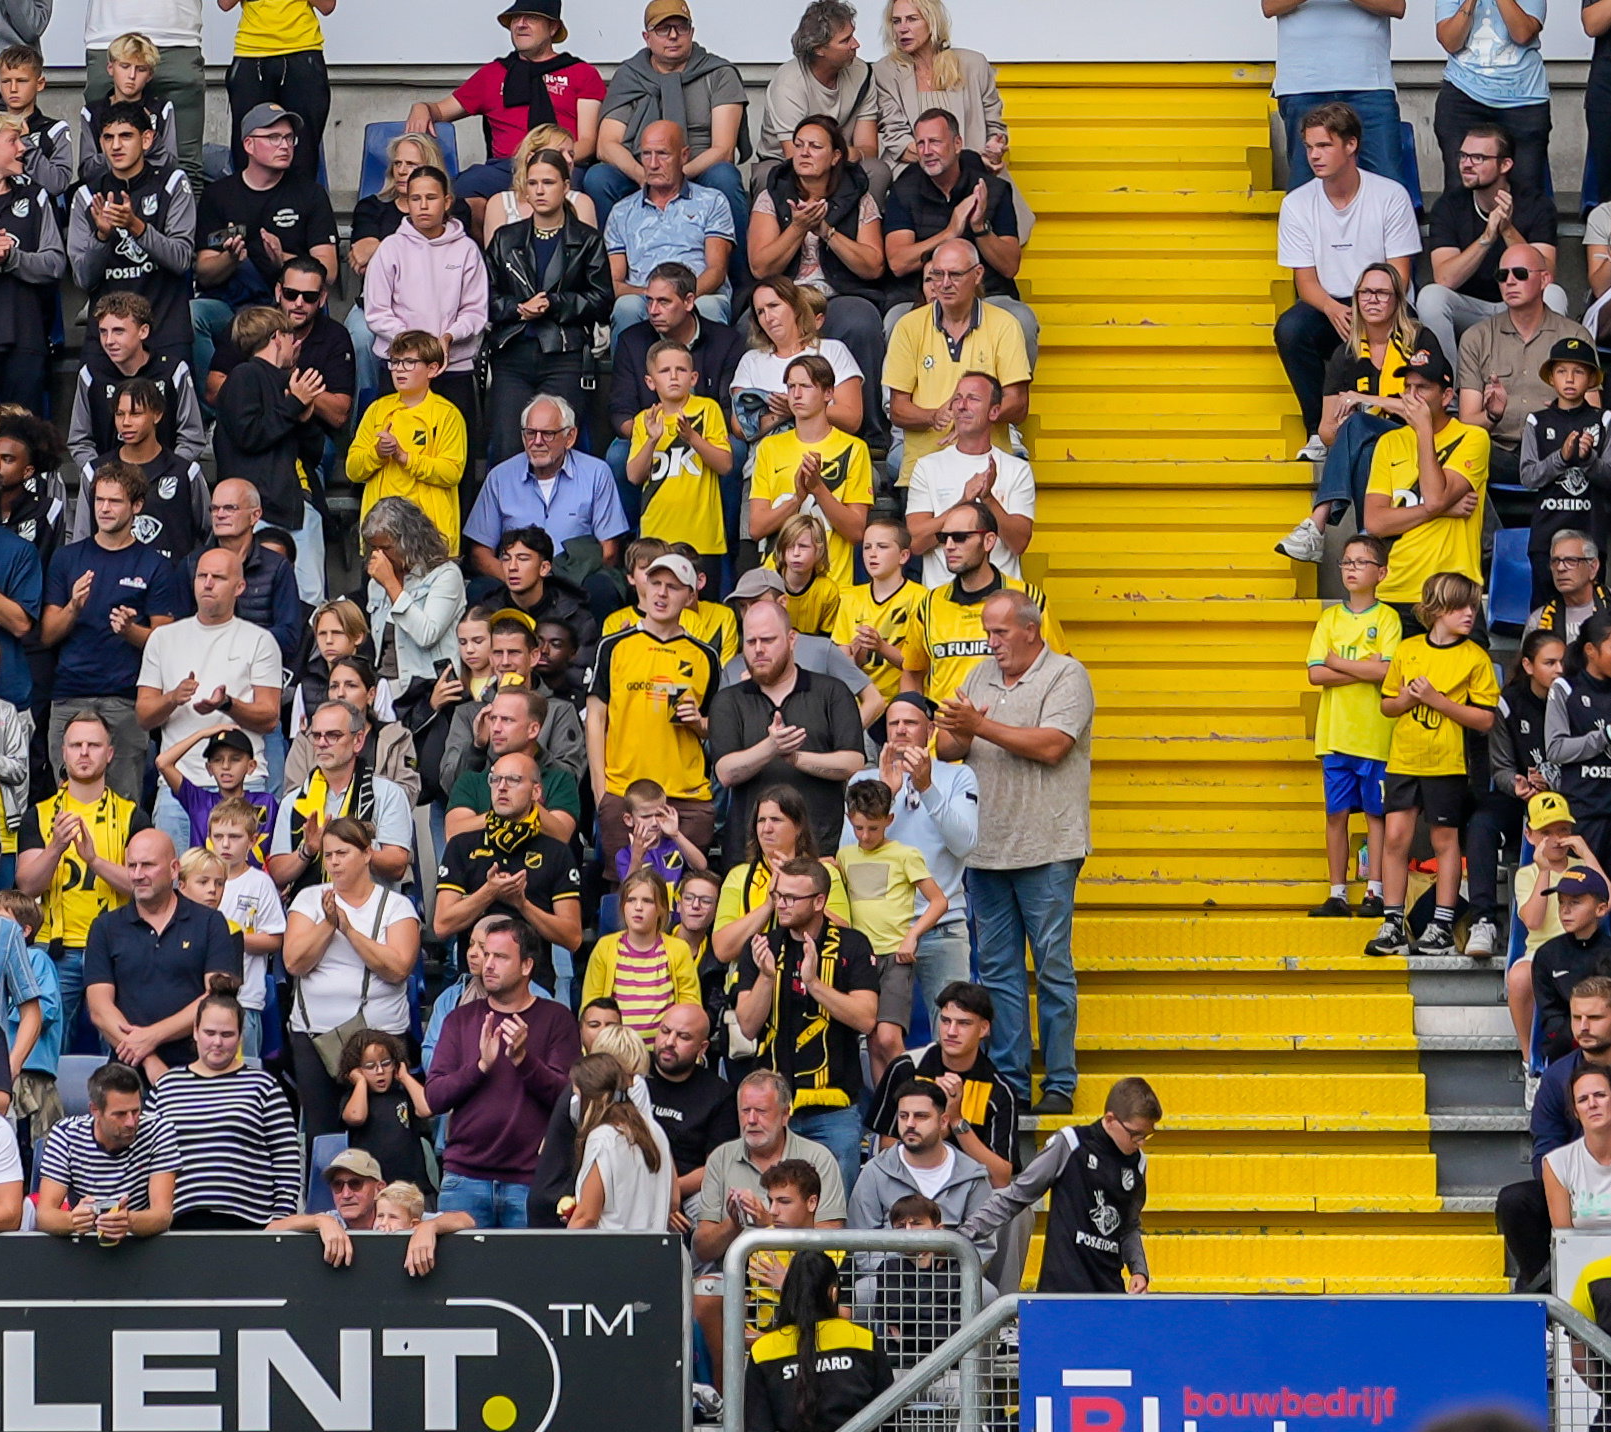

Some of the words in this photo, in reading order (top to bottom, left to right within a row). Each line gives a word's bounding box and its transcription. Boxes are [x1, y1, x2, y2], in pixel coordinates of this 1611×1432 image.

[1540, 497, 1593, 512] OSEIDO
[947, 640, 995, 657] FUJIF
[1076, 1230, 1119, 1254] POSEIDO
[783, 1355, 853, 1382] STARD
[1183, 1386, 1398, 1425] bouwbedrijf
